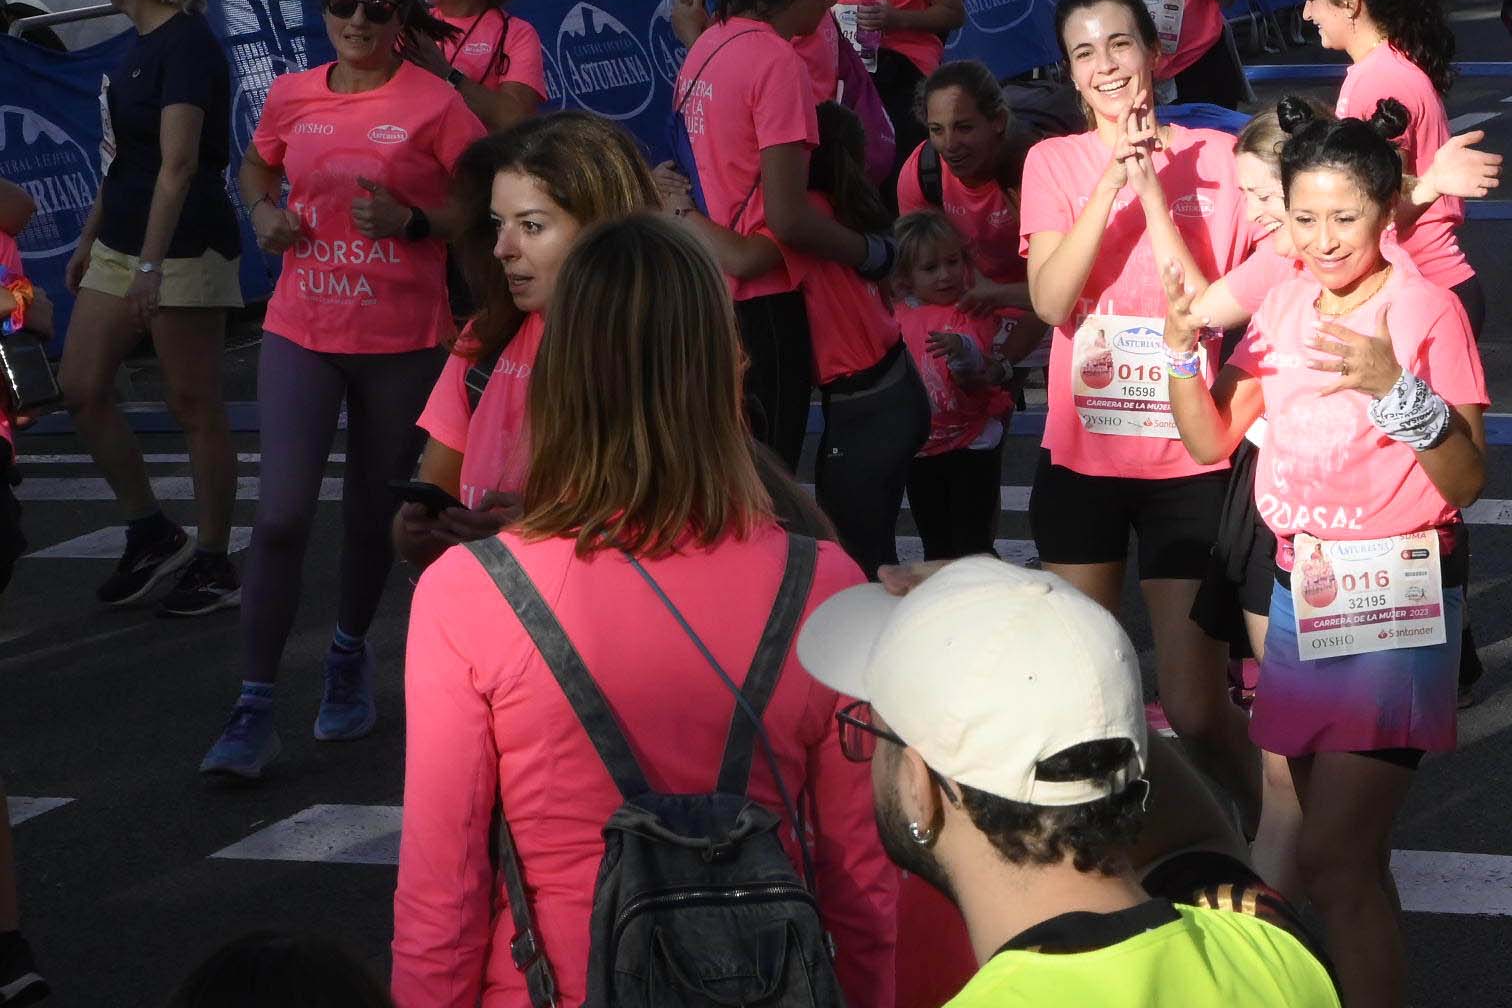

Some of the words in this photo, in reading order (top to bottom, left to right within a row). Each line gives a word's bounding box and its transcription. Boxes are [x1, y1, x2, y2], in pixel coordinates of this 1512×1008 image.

[565, 49, 650, 95] ASTURIANA
[294, 123, 335, 137] OYSHO
[295, 239, 401, 265] DORSAL
[1118, 363, 1163, 382] 016
[1121, 386, 1156, 398] 16598
[1086, 399, 1121, 408] CARRERA
[1123, 400, 1135, 409] DE
[1135, 401, 1146, 410] LA
[1342, 569, 1390, 592] 016
[1349, 594, 1386, 610] 32195
[1314, 613, 1352, 629] CARRERA
[1353, 615, 1366, 624] DE
[1366, 613, 1378, 623] LA
[1380, 610, 1407, 621] MUJER
[1409, 608, 1429, 617] 2023
[1312, 634, 1354, 649] OYSHO
[1390, 627, 1434, 639] Santander
